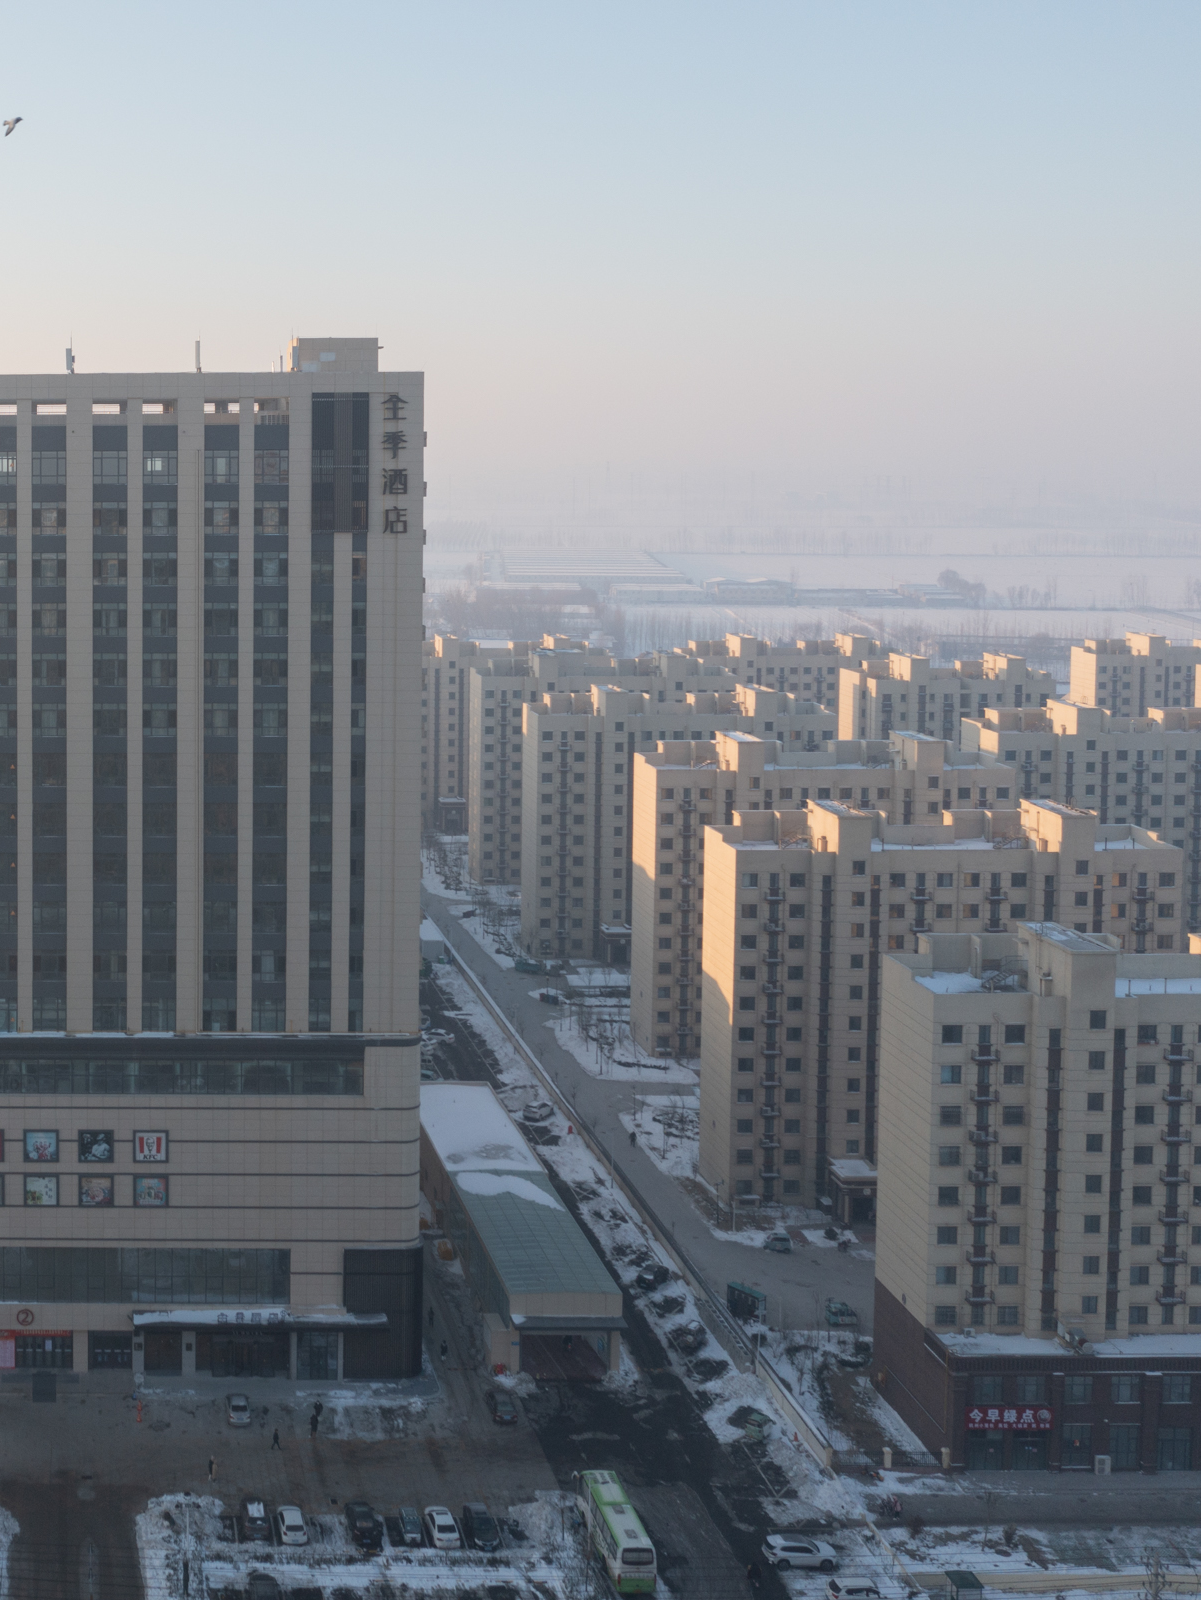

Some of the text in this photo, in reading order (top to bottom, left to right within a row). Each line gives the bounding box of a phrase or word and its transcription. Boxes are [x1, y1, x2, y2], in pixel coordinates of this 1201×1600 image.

[381, 394, 409, 534] 全季酒店
[969, 1408, 1035, 1423] 今早绿点
